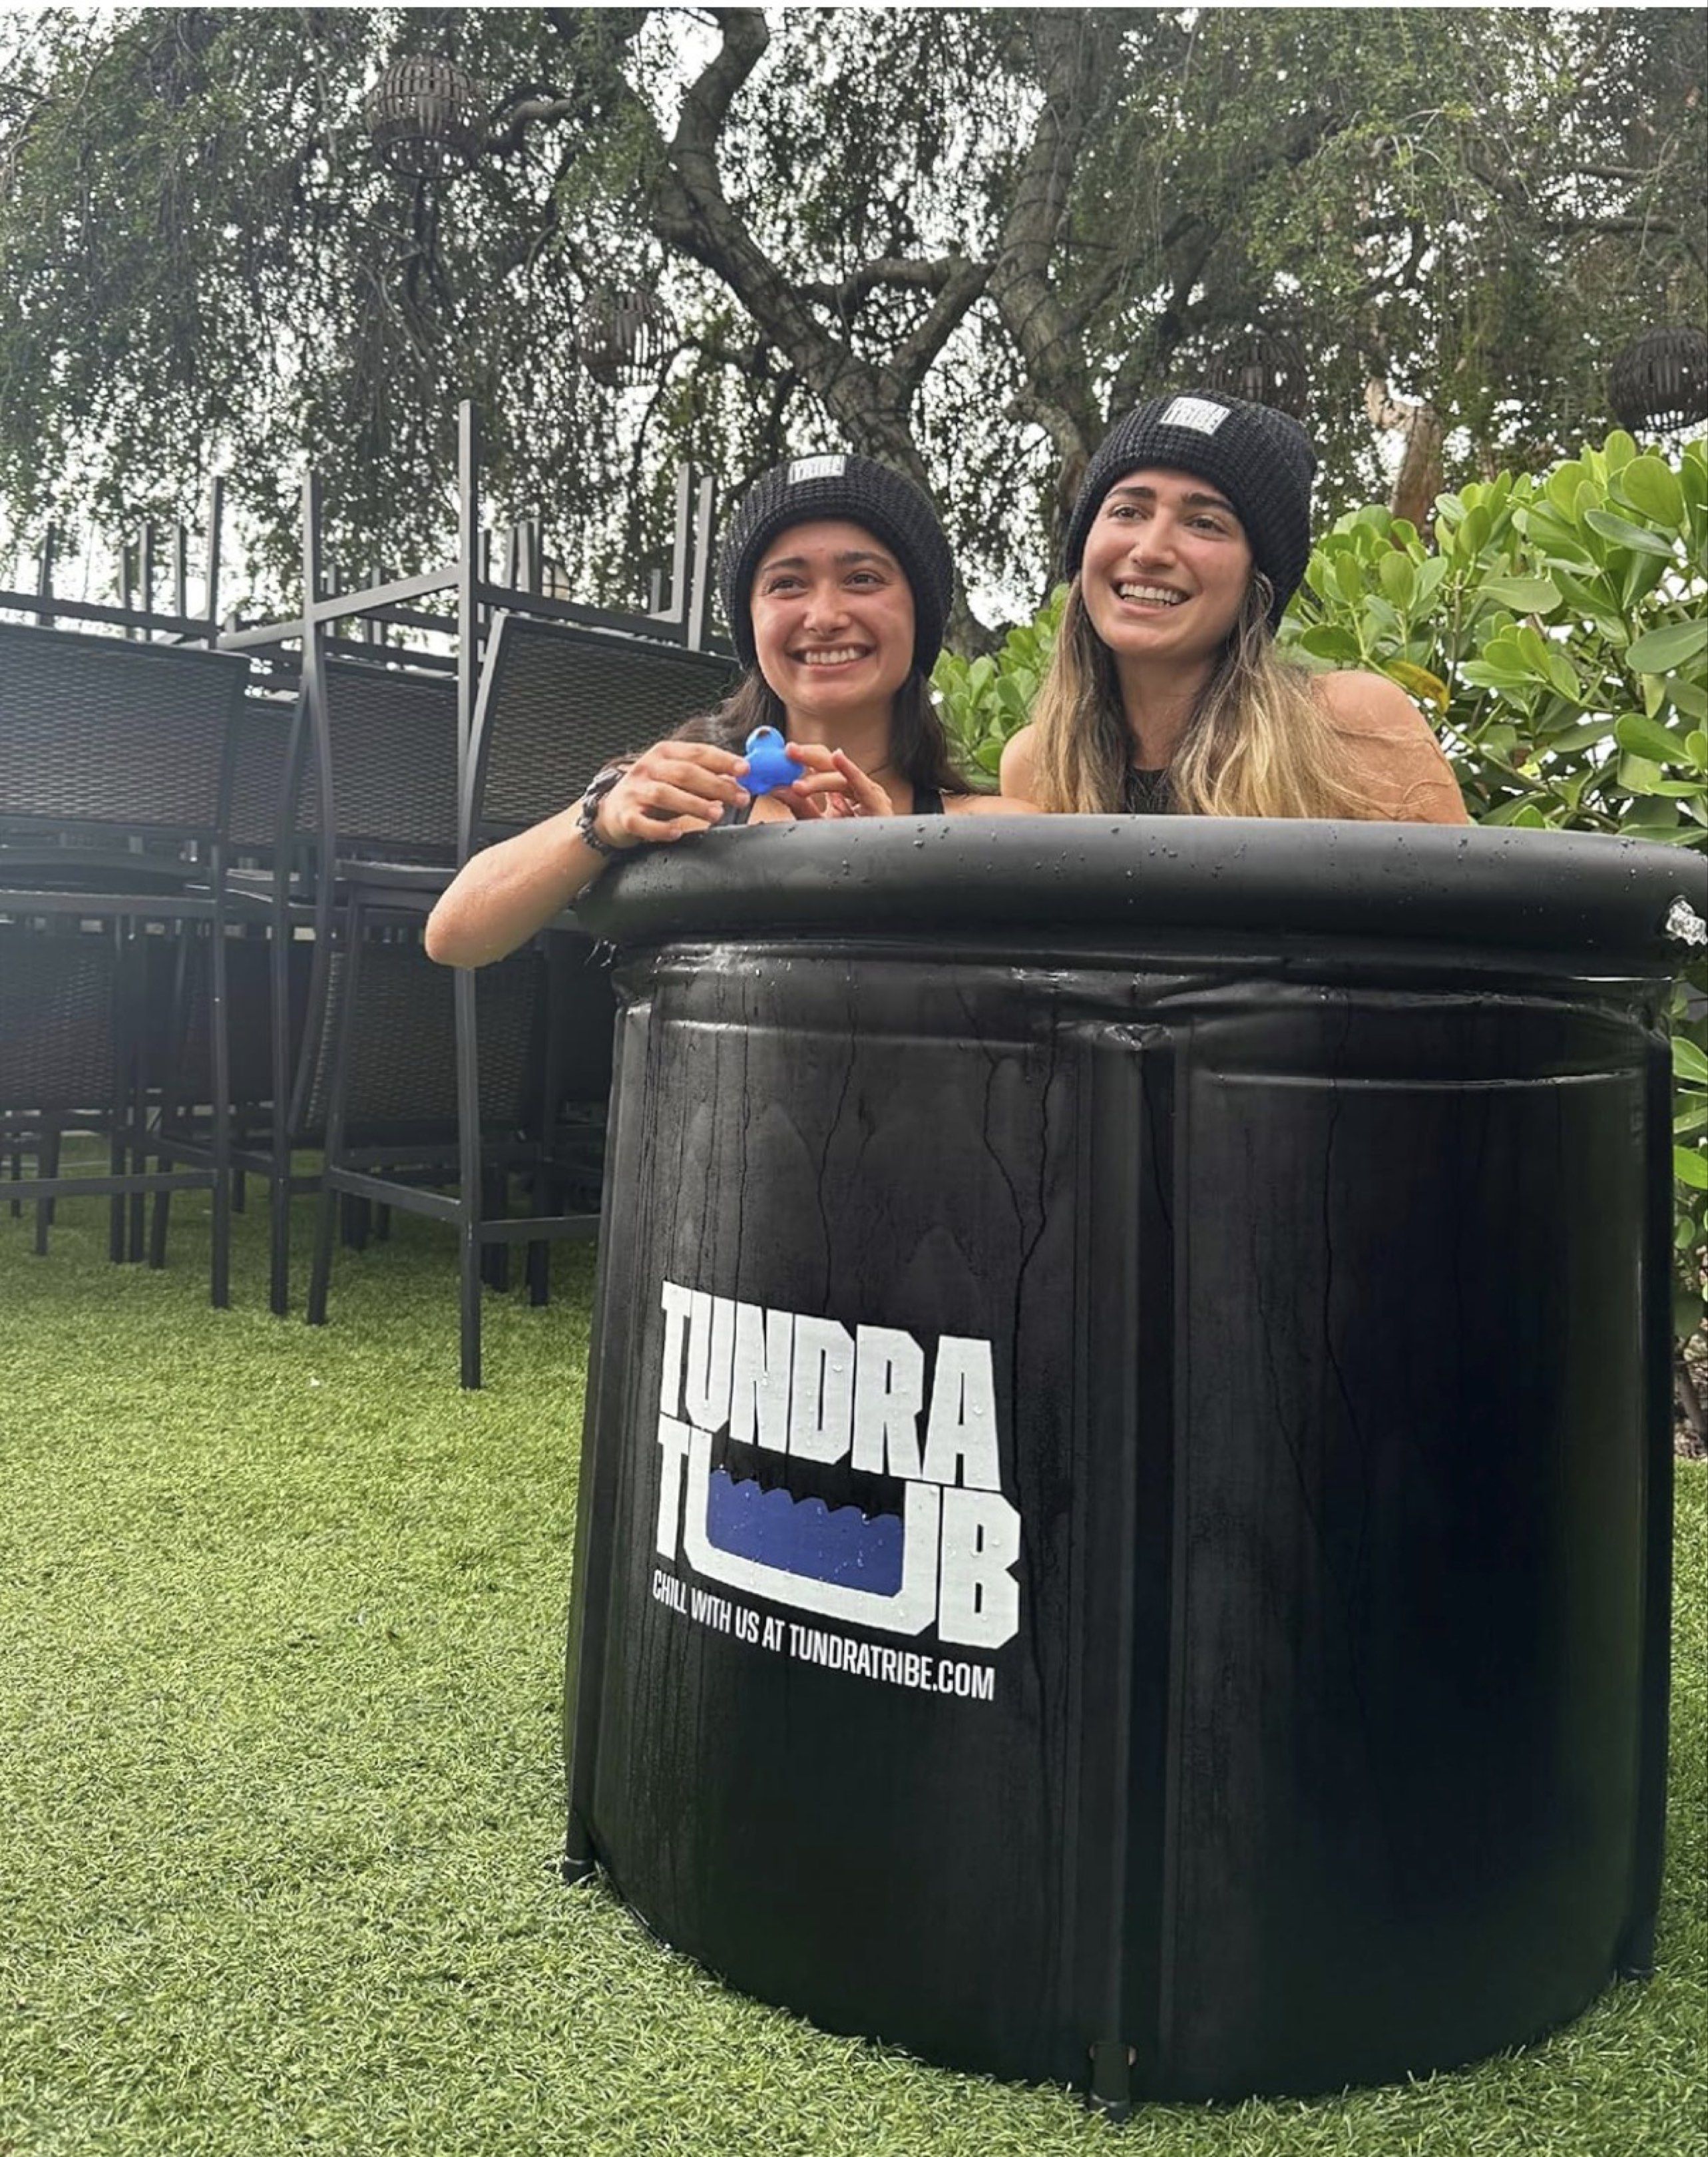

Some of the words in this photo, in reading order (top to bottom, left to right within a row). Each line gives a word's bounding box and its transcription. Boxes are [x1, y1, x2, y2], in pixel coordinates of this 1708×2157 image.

[660, 1281, 1001, 1491] TUNDRA
[652, 1569, 687, 1614] CHILL
[691, 1586, 732, 1634] WITH
[736, 1605, 760, 1644] US
[761, 1615, 785, 1652] AT
[789, 1622, 995, 1701] TUNDRATRIBE.COM
[657, 1413, 1021, 1649] TUB
